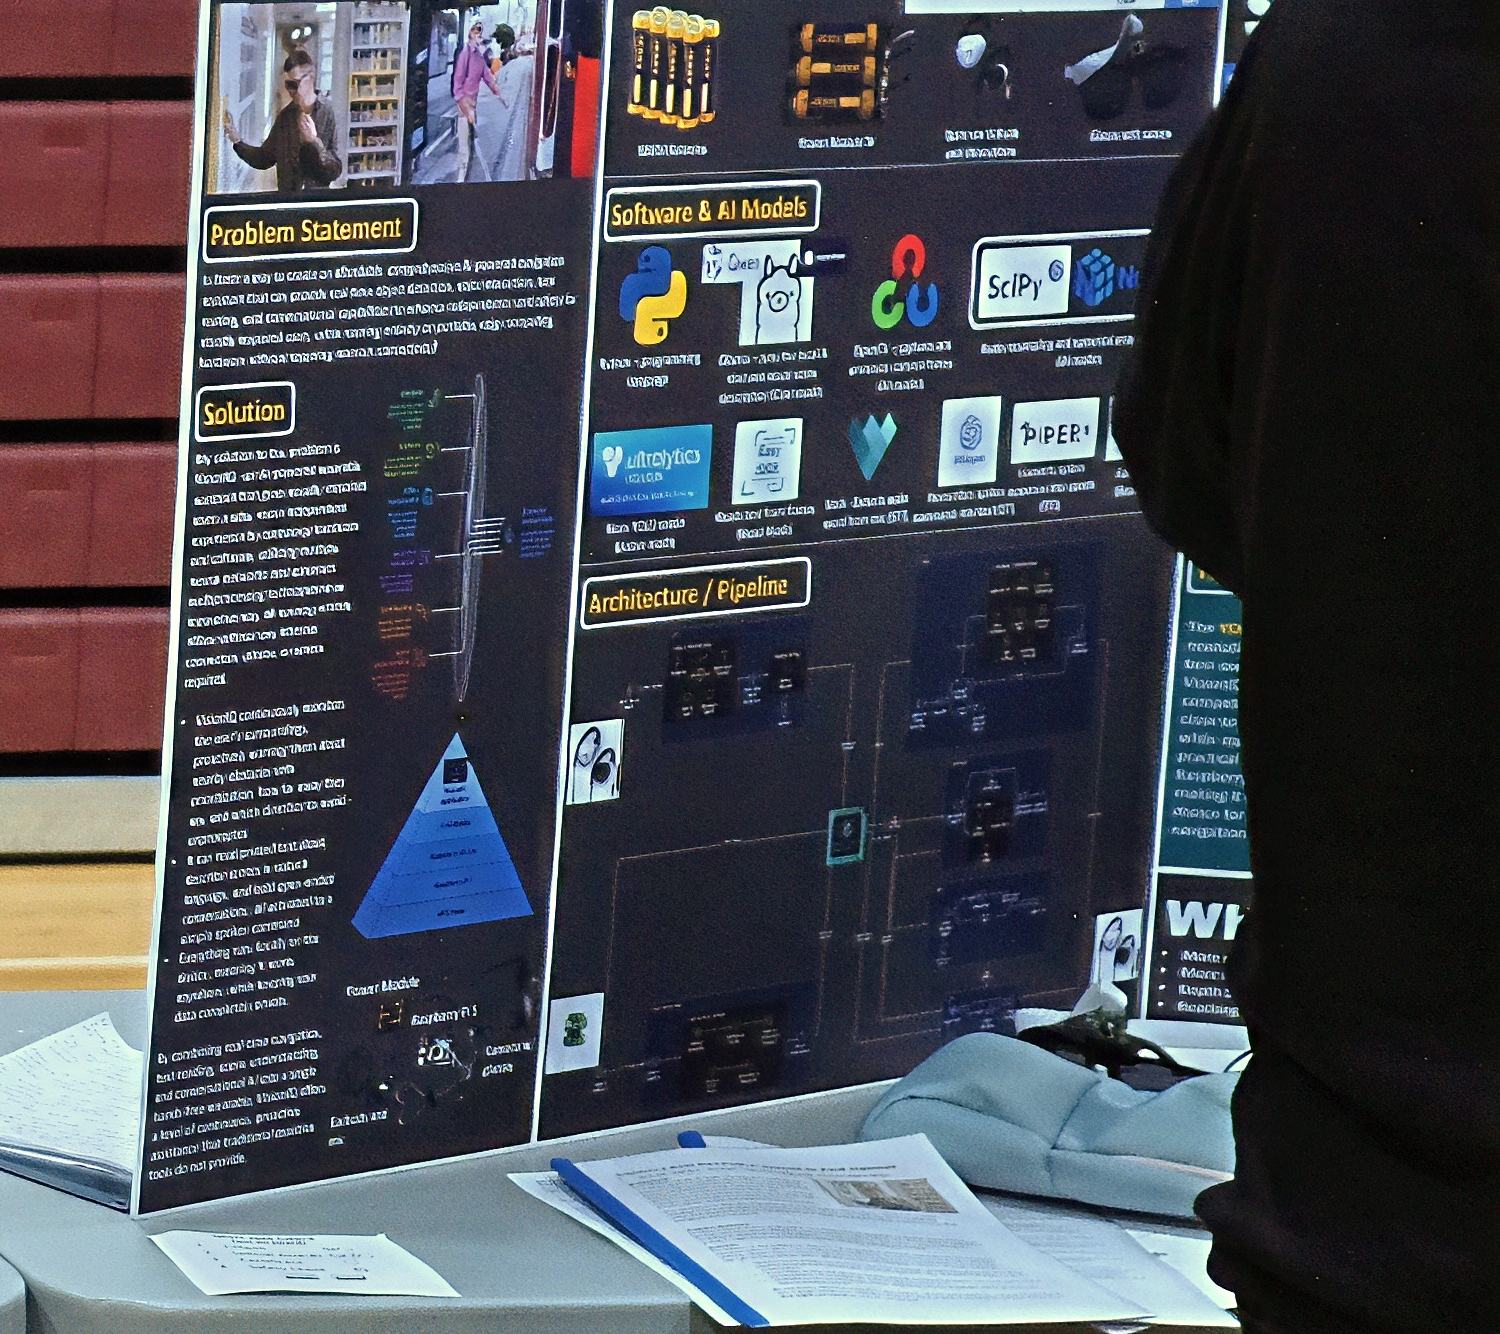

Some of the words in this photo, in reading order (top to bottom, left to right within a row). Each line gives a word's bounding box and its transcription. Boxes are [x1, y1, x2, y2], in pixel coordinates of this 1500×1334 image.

[610, 197, 694, 226] Software
[742, 196, 807, 221] Models
[210, 223, 295, 249] Problem
[301, 217, 402, 242] Statement
[203, 400, 285, 426] Solution
[588, 583, 699, 613] Architecture
[718, 575, 788, 601] Pipeline
